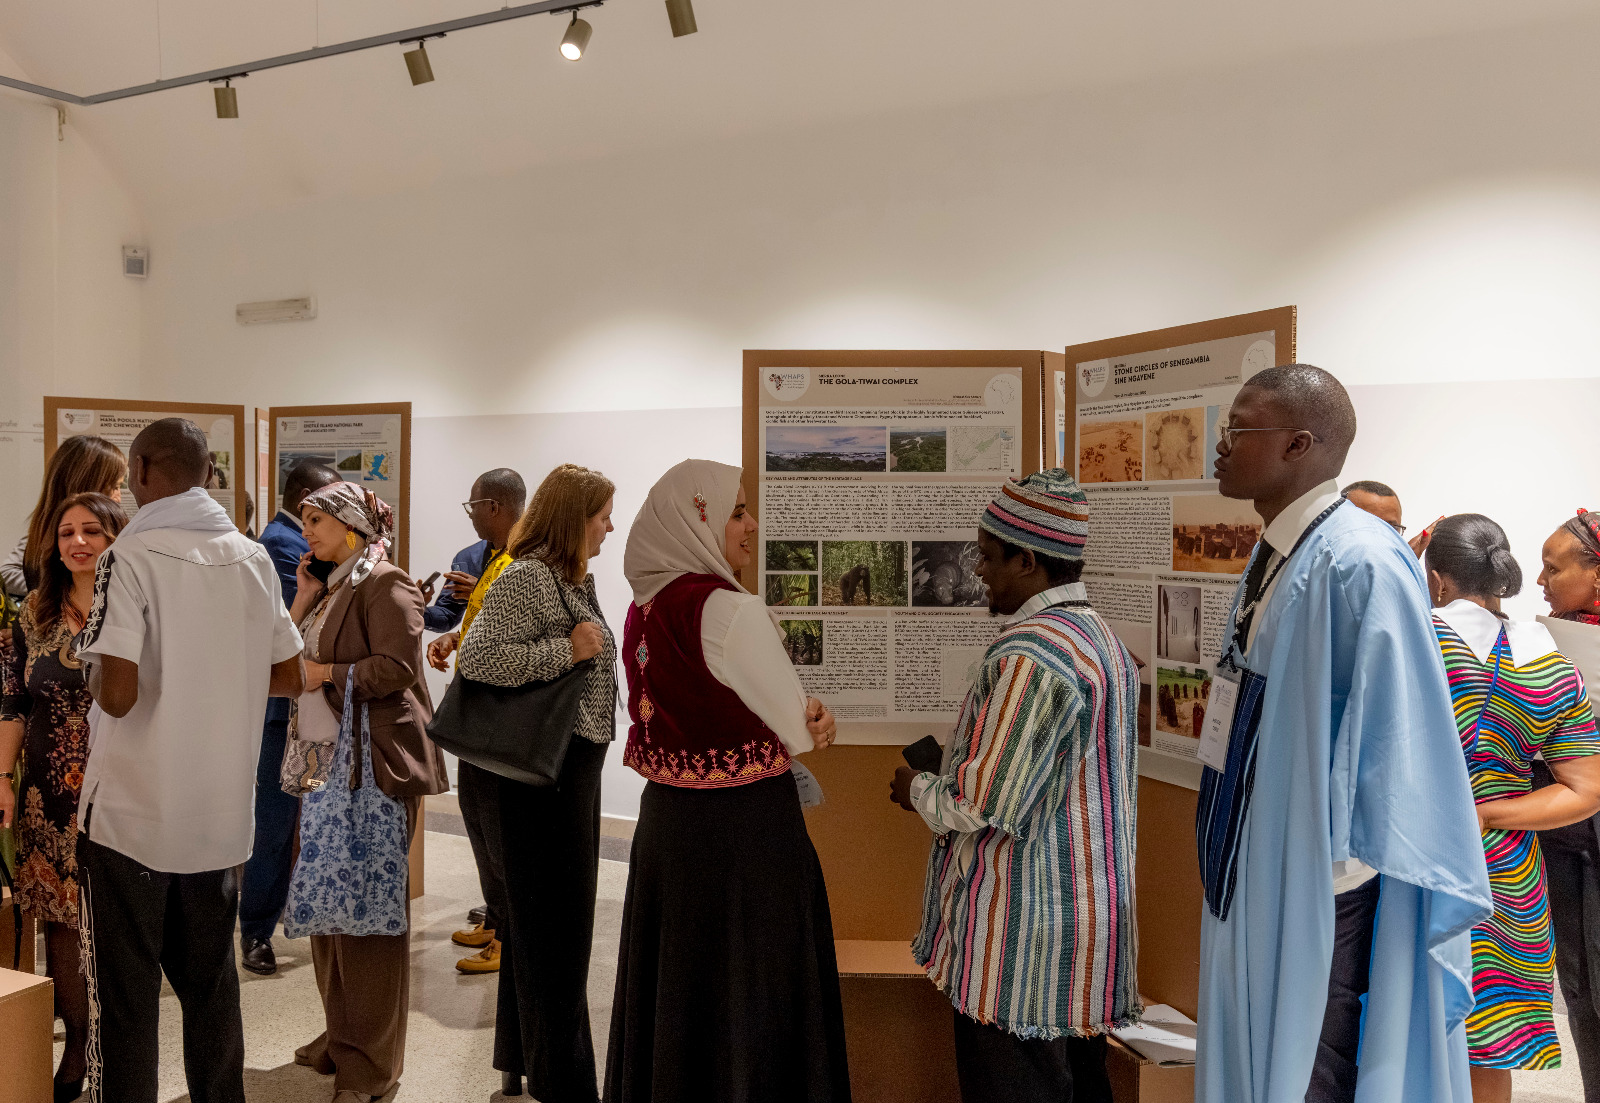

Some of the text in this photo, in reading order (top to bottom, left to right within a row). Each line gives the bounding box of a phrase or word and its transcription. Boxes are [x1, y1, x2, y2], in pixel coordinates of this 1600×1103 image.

[1114, 366, 1132, 376] STONE
[1134, 362, 1158, 372] CIRCLES
[1170, 354, 1210, 368] SENEGAMBIA
[1128, 372, 1155, 382] NGAYENE
